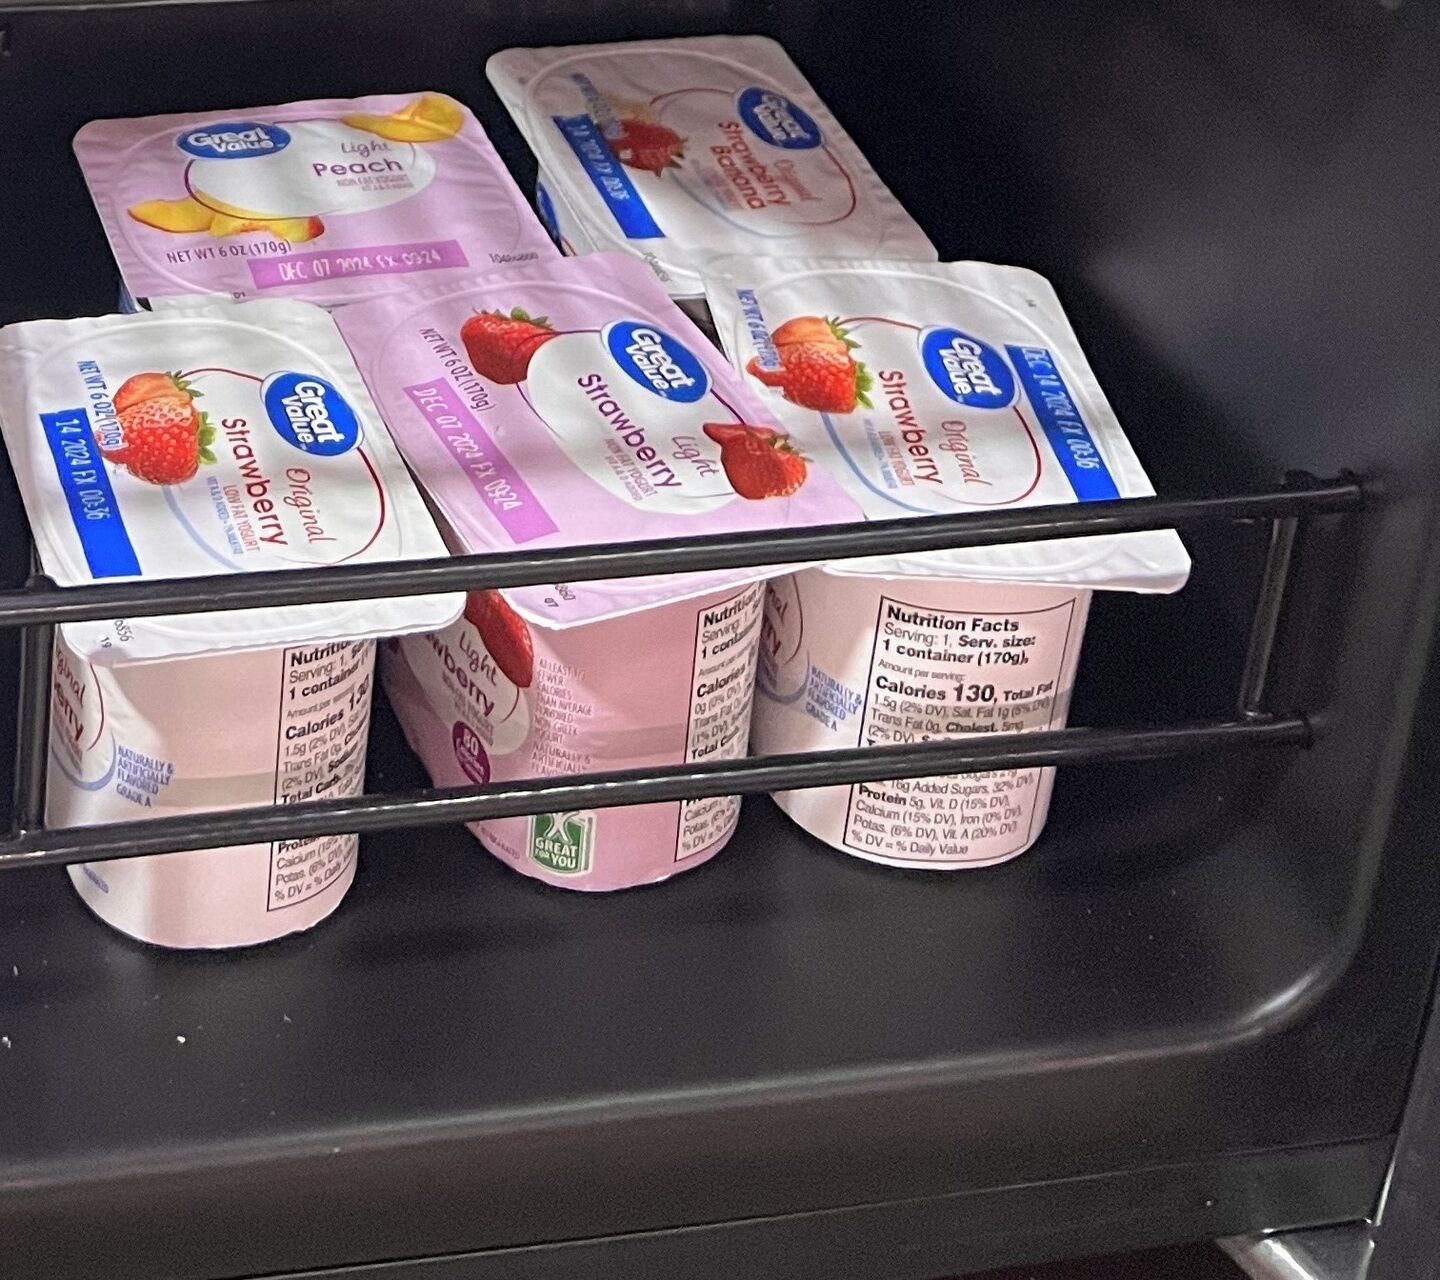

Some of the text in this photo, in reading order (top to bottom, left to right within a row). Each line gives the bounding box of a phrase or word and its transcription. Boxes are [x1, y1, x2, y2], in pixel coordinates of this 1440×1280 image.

[187, 127, 271, 147] Great
[213, 139, 274, 153] Value
[340, 141, 390, 157] Light
[312, 158, 403, 177] Peach
[719, 121, 791, 205] Strawberry
[710, 146, 767, 209] Banana
[166, 250, 192, 264] NET
[194, 248, 215, 261] WT
[219, 246, 227, 258] 6
[278, 259, 330, 281] DEC 07
[419, 328, 445, 343] NET
[433, 343, 456, 359] WT
[444, 359, 457, 367] 6
[631, 329, 695, 389] Great
[1021, 348, 1052, 369] DEC
[77, 360, 100, 375] NET
[626, 343, 670, 393] Value
[939, 349, 972, 395] Value
[951, 338, 1002, 396] Great
[84, 374, 107, 390] WT
[90, 392, 109, 400] 6
[281, 395, 314, 443] Value
[295, 381, 344, 443] Great
[56, 419, 81, 433] 14
[413, 388, 496, 478] DEC 07 2024 FX
[578, 374, 682, 487] Strawberry
[878, 370, 943, 485] Strawberry
[61, 439, 91, 465] 2024
[672, 436, 719, 477] Light
[939, 420, 993, 486] Original
[72, 469, 97, 485] FX
[221, 418, 288, 545] Strawberry
[284, 468, 337, 543] Original
[237, 521, 260, 551] YOGURT
[704, 589, 757, 628] Nutrition
[887, 604, 1019, 632] Nutrition Facts
[884, 622, 1036, 648] Serving: Serv. size:
[460, 632, 497, 686] Light
[702, 646, 707, 659] 1
[883, 639, 974, 663] 1 container
[290, 687, 296, 700] 1
[302, 659, 359, 696] container
[697, 662, 745, 697] Calories
[878, 659, 929, 678] Amount per
[876, 675, 1053, 704] Calories 130, Total Fat
[874, 693, 897, 712] 1.5g
[900, 701, 922, 714] (2%
[286, 708, 344, 740] Calories
[805, 702, 837, 732] GRADE A
[870, 708, 923, 730] Trans Fat
[868, 725, 890, 742] (2%
[118, 745, 166, 773] NATURALLY
[285, 743, 306, 756] 1.5g
[692, 741, 718, 760] Total
[283, 756, 312, 773] Trans
[117, 771, 159, 795] FLAVORED
[282, 786, 312, 804] Total
[912, 782, 948, 794] Added
[116, 784, 152, 808] GRADE A
[858, 783, 907, 805] Protein
[948, 798, 958, 809] D
[960, 797, 987, 811] (15%
[856, 800, 979, 824] Calcium (15% Iron
[865, 833, 969, 856] DV Daily Value
[961, 829, 969, 840] A
[535, 837, 578, 857] GREAT
[550, 854, 576, 868] YOU
[288, 881, 304, 898] DV
